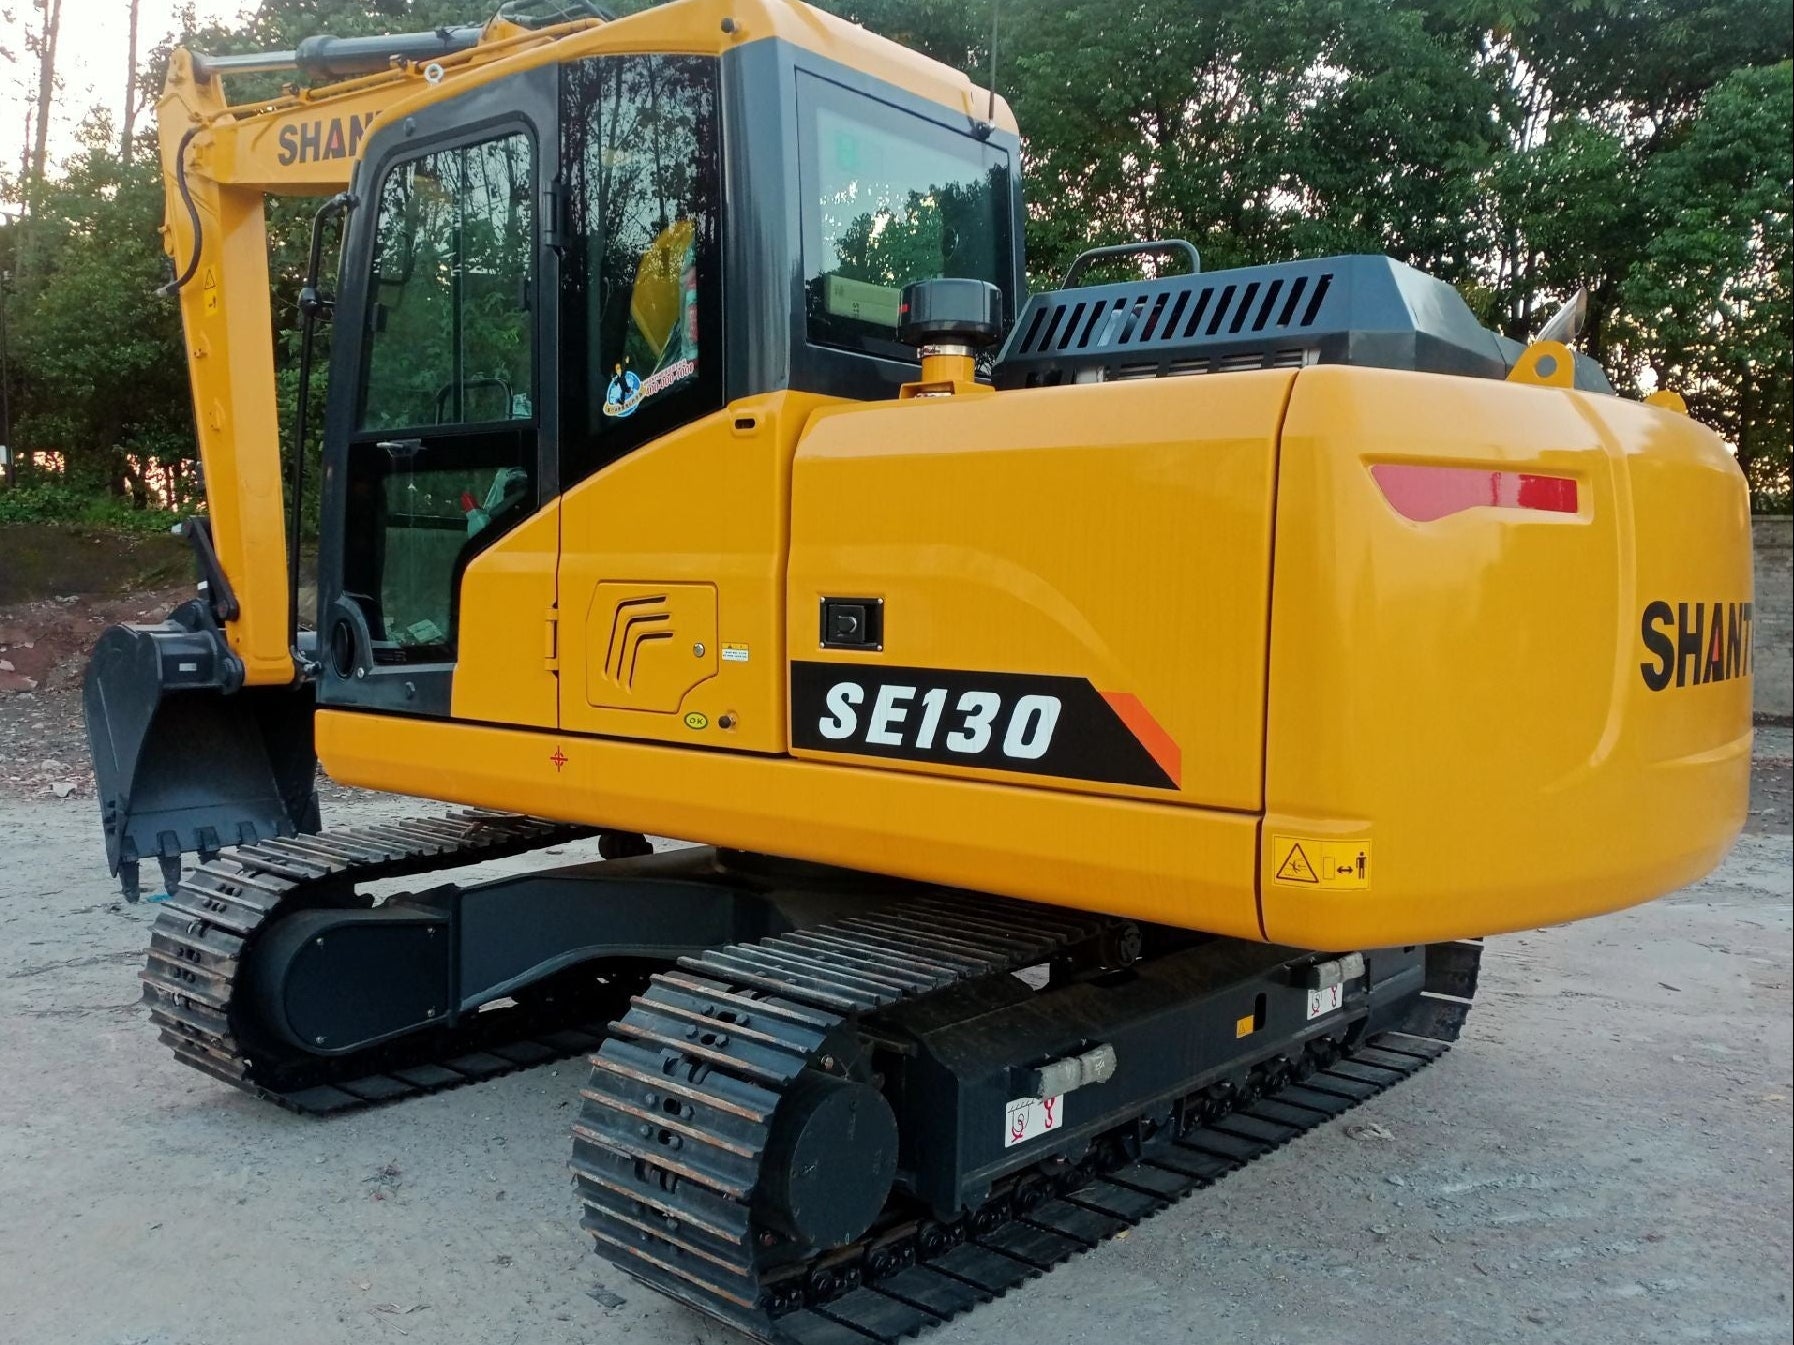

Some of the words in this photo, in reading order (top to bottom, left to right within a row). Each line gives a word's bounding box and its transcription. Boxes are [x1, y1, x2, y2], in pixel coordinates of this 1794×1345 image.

[277, 110, 382, 166] SHAN
[1640, 600, 1753, 692] SHANT
[689, 717, 704, 725] OK
[818, 681, 1062, 760] SE130
